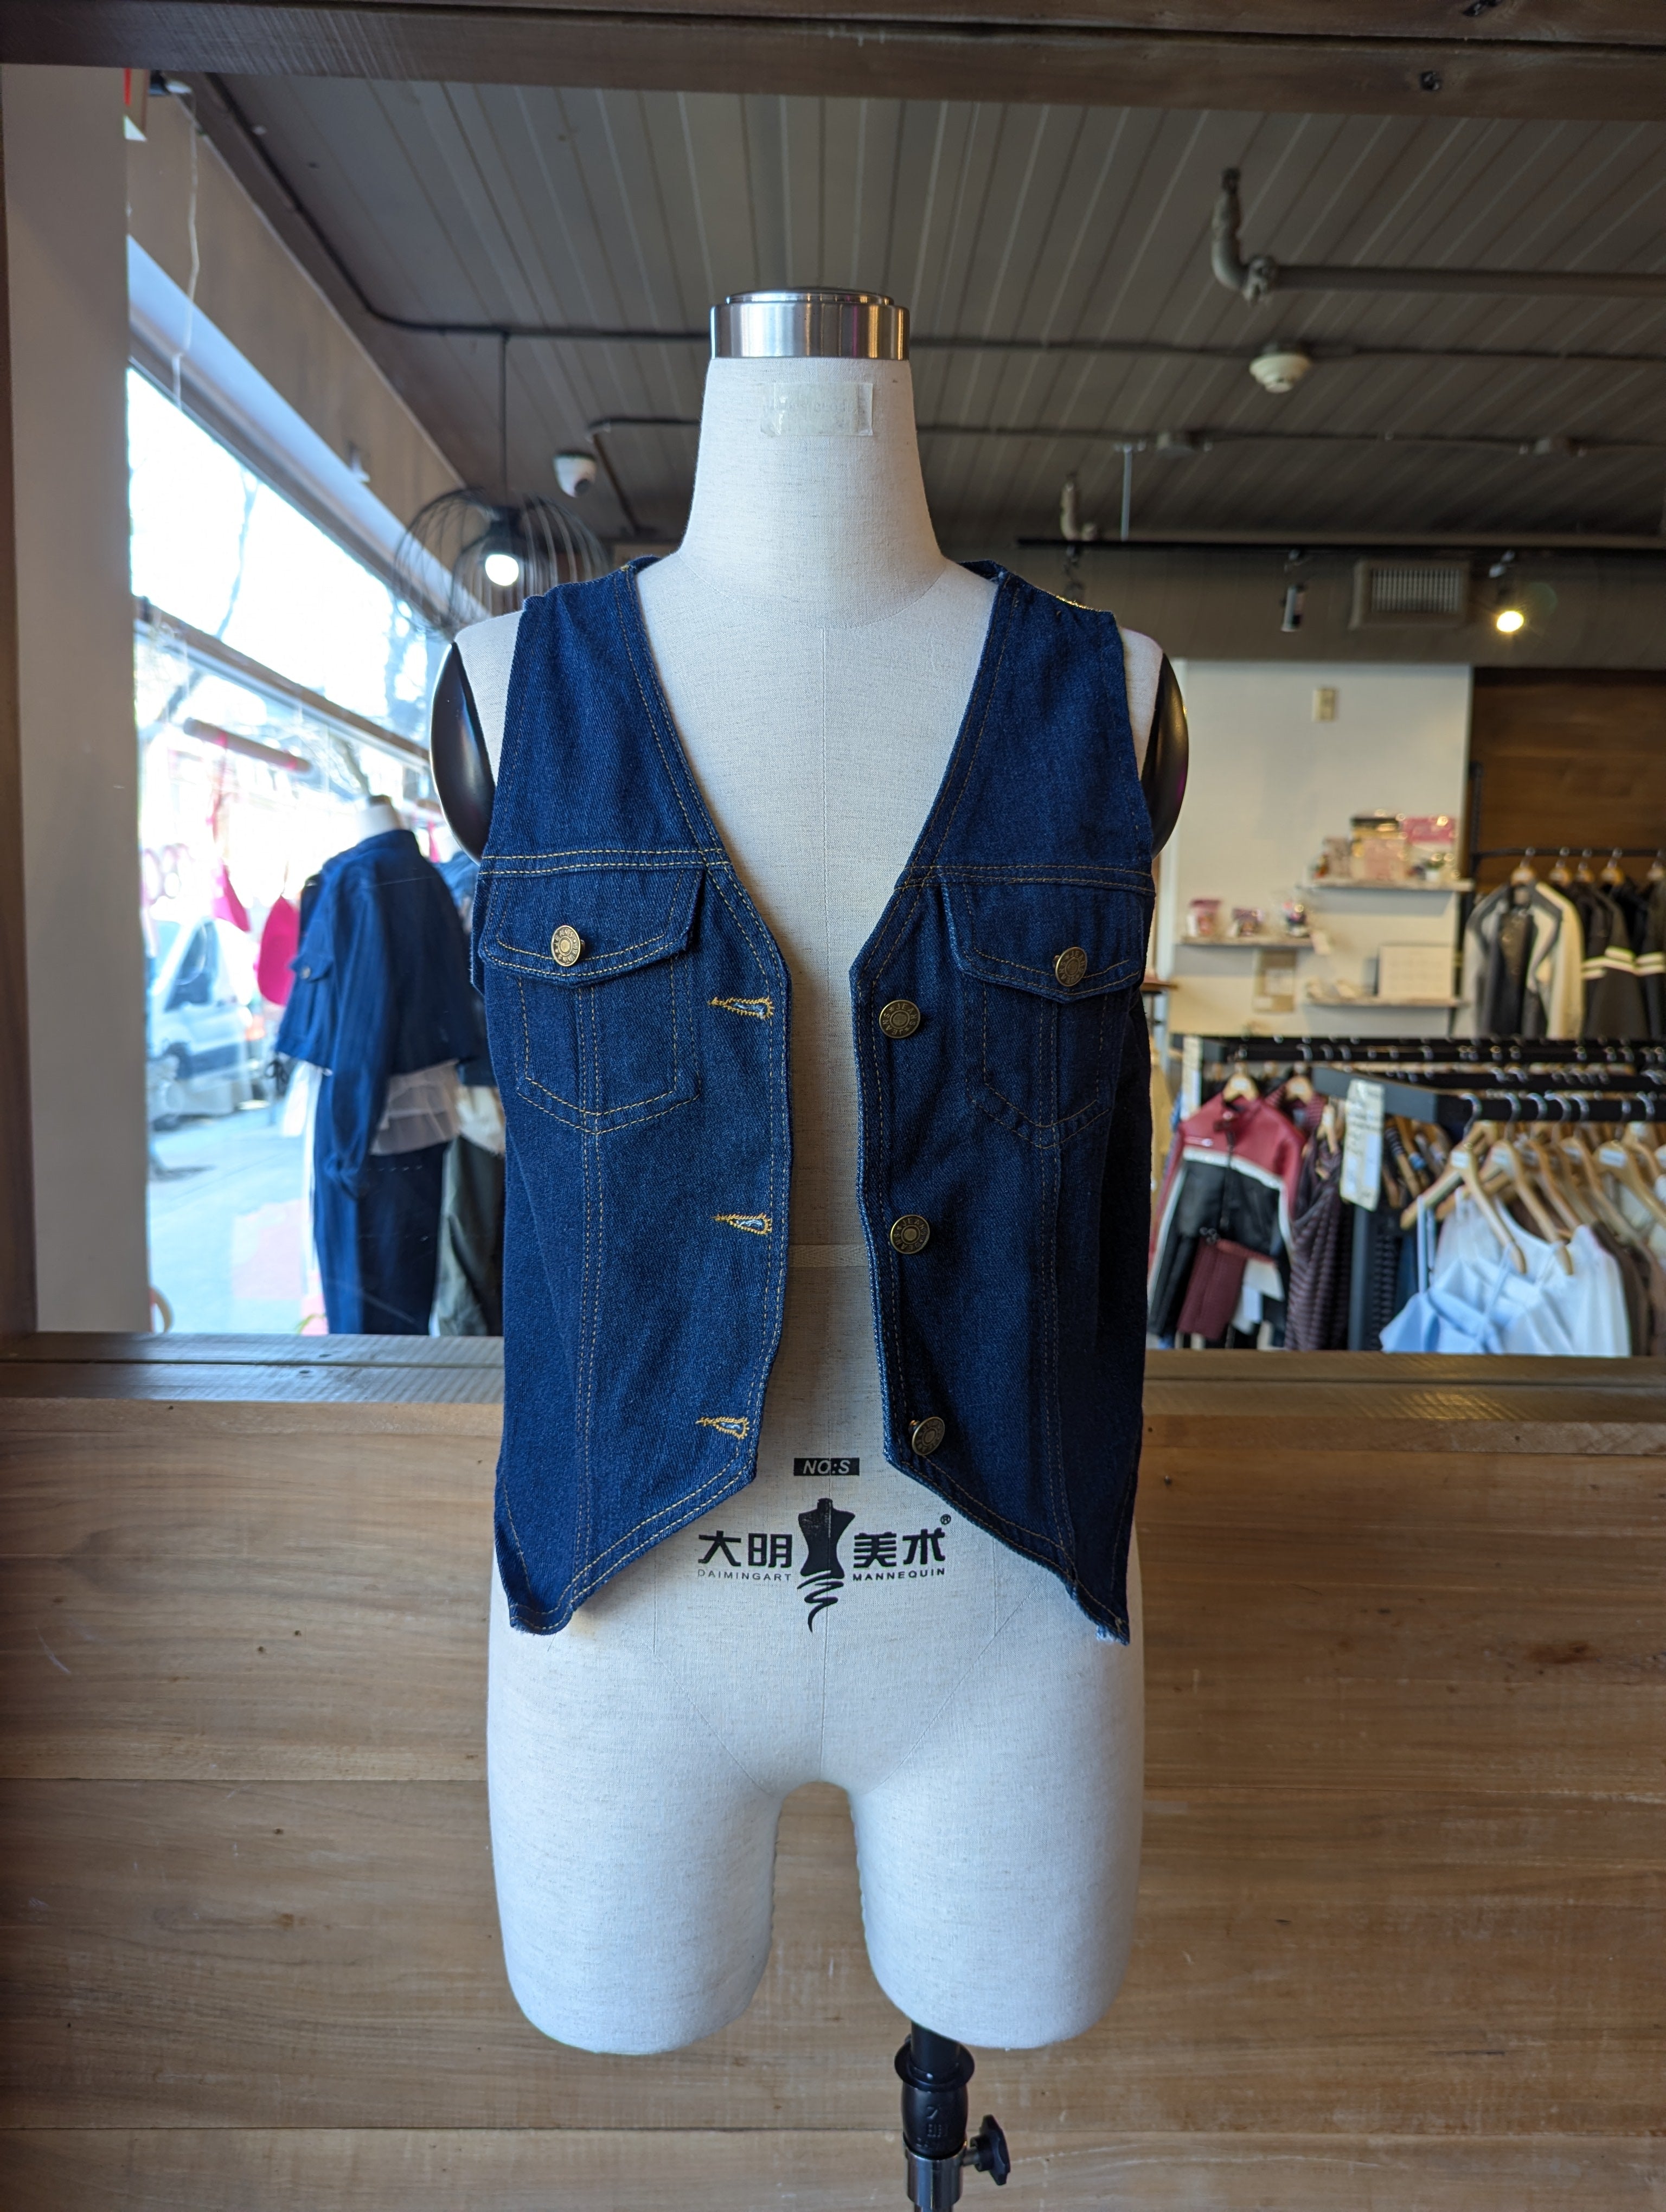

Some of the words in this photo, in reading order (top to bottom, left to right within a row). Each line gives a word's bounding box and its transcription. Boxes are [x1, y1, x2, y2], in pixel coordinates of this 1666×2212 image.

[803, 1459, 850, 1474] NO:S
[698, 1530, 792, 1568] 大明
[853, 1527, 945, 1568] 美术
[697, 1568, 791, 1581] DAIMINGART
[853, 1567, 945, 1581] MANNEQUIN
